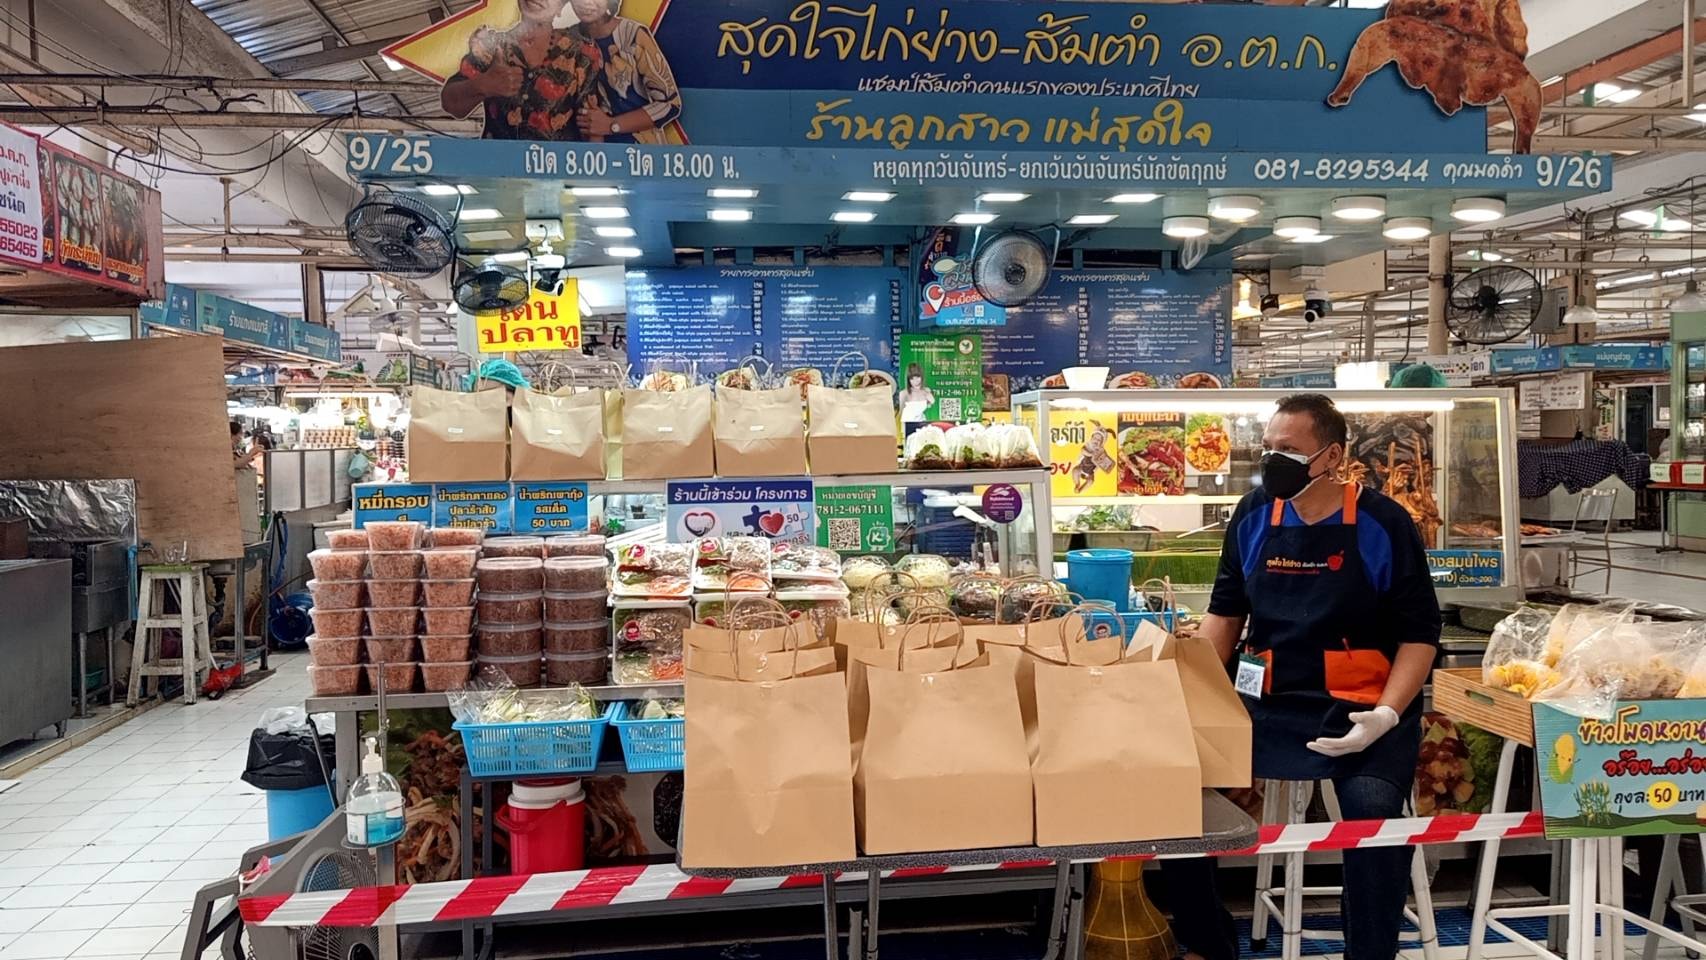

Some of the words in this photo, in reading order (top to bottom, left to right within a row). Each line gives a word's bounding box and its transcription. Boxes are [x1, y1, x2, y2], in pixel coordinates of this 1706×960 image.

[1181, 34, 1338, 70] อ.ต.ก.
[857, 72, 1200, 98] แชมป์ส้มตำคนแรกของประเทศไทย
[806, 98, 1031, 150] ร้านลูกสาว
[1044, 98, 1212, 152] แม่สุดใจ
[349, 138, 433, 174] 9/25
[525, 144, 557, 176] เปิด
[566, 149, 607, 176] 8.00
[626, 146, 653, 177] ปิด
[663, 152, 713, 179] 18.00
[722, 154, 740, 179] น.
[1253, 159, 1429, 182] 081-8295344
[1536, 155, 1602, 188] 9/26
[481, 322, 580, 348] ปลาทู
[359, 489, 430, 510] หมี่กรอบ
[674, 484, 752, 502] ร้านนี้เข้าร่วม
[755, 488, 808, 501] โครงการ
[535, 502, 567, 514] รสเด็ด
[786, 514, 800, 524] 50
[816, 504, 884, 515] 781-2-067111
[532, 519, 545, 528] 50
[550, 518, 571, 528] บาท
[1613, 791, 1650, 813] ถุงละ
[1654, 788, 1672, 803] 50
[1678, 789, 1705, 803] บาท
